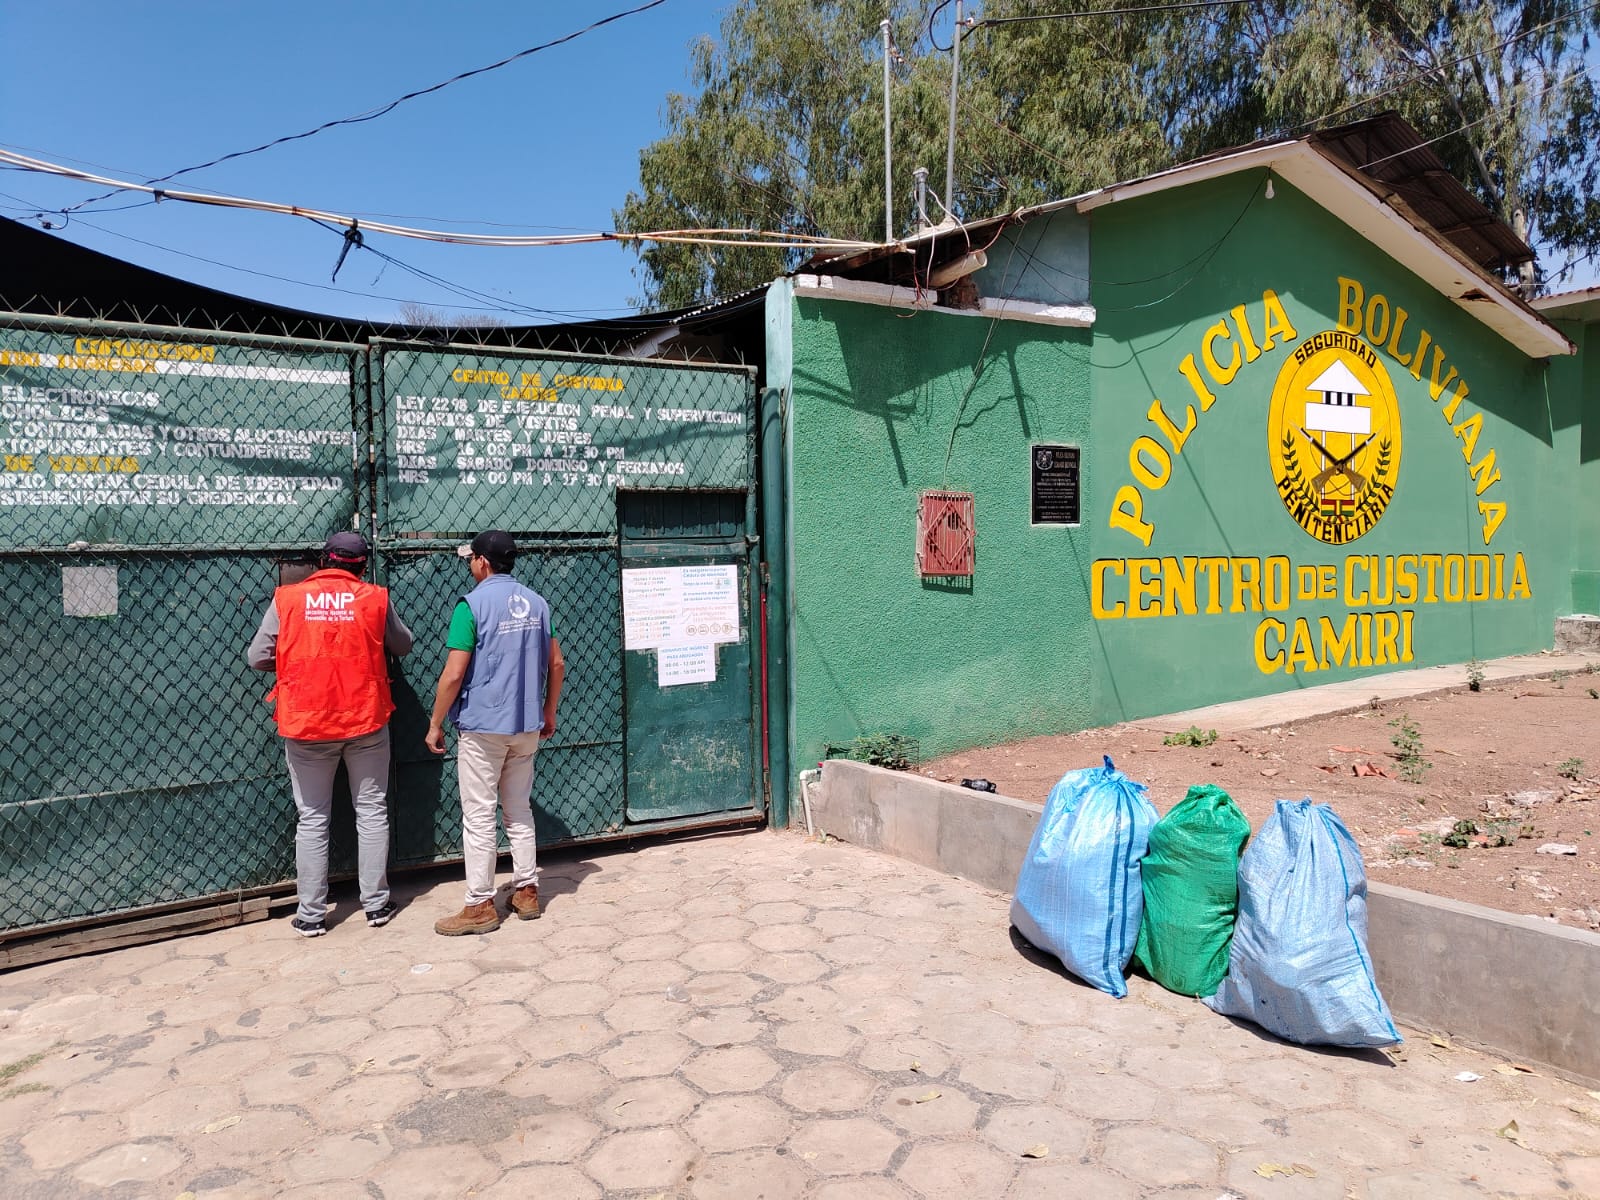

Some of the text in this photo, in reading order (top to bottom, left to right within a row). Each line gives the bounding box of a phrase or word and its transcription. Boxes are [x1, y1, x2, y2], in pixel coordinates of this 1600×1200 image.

[1295, 332, 1377, 368] SEGURIDAD
[452, 368, 625, 391] CENTRO DE CUSTODIA
[396, 396, 428, 411] LEY
[478, 399, 498, 413] DE
[591, 404, 634, 419] PENAL
[643, 407, 652, 420] Y
[1109, 276, 1508, 546] POLICIA BOLIVIANA
[396, 410, 475, 427] HORARIOS
[485, 413, 506, 429] DE
[158, 424, 170, 440] Y
[173, 425, 231, 442] OTROS
[397, 426, 592, 445] DIAS MARTES Y JUEVES
[157, 440, 168, 457] Y
[512, 444, 533, 458] PM
[544, 445, 553, 458] A
[607, 447, 625, 460] PM
[397, 455, 438, 470] DIAS
[456, 457, 513, 472] SABADO
[599, 460, 607, 472] Y
[214, 475, 241, 491] DE
[398, 470, 430, 484] HRS
[513, 472, 533, 485] PM
[543, 473, 552, 486] A
[607, 474, 626, 487] PM
[1278, 476, 1394, 543] PENITENCIARIA
[1091, 551, 1531, 620] CENTRO DE CUSTODIA
[306, 592, 355, 609] MNP
[1253, 609, 1415, 674] CAMIRI
